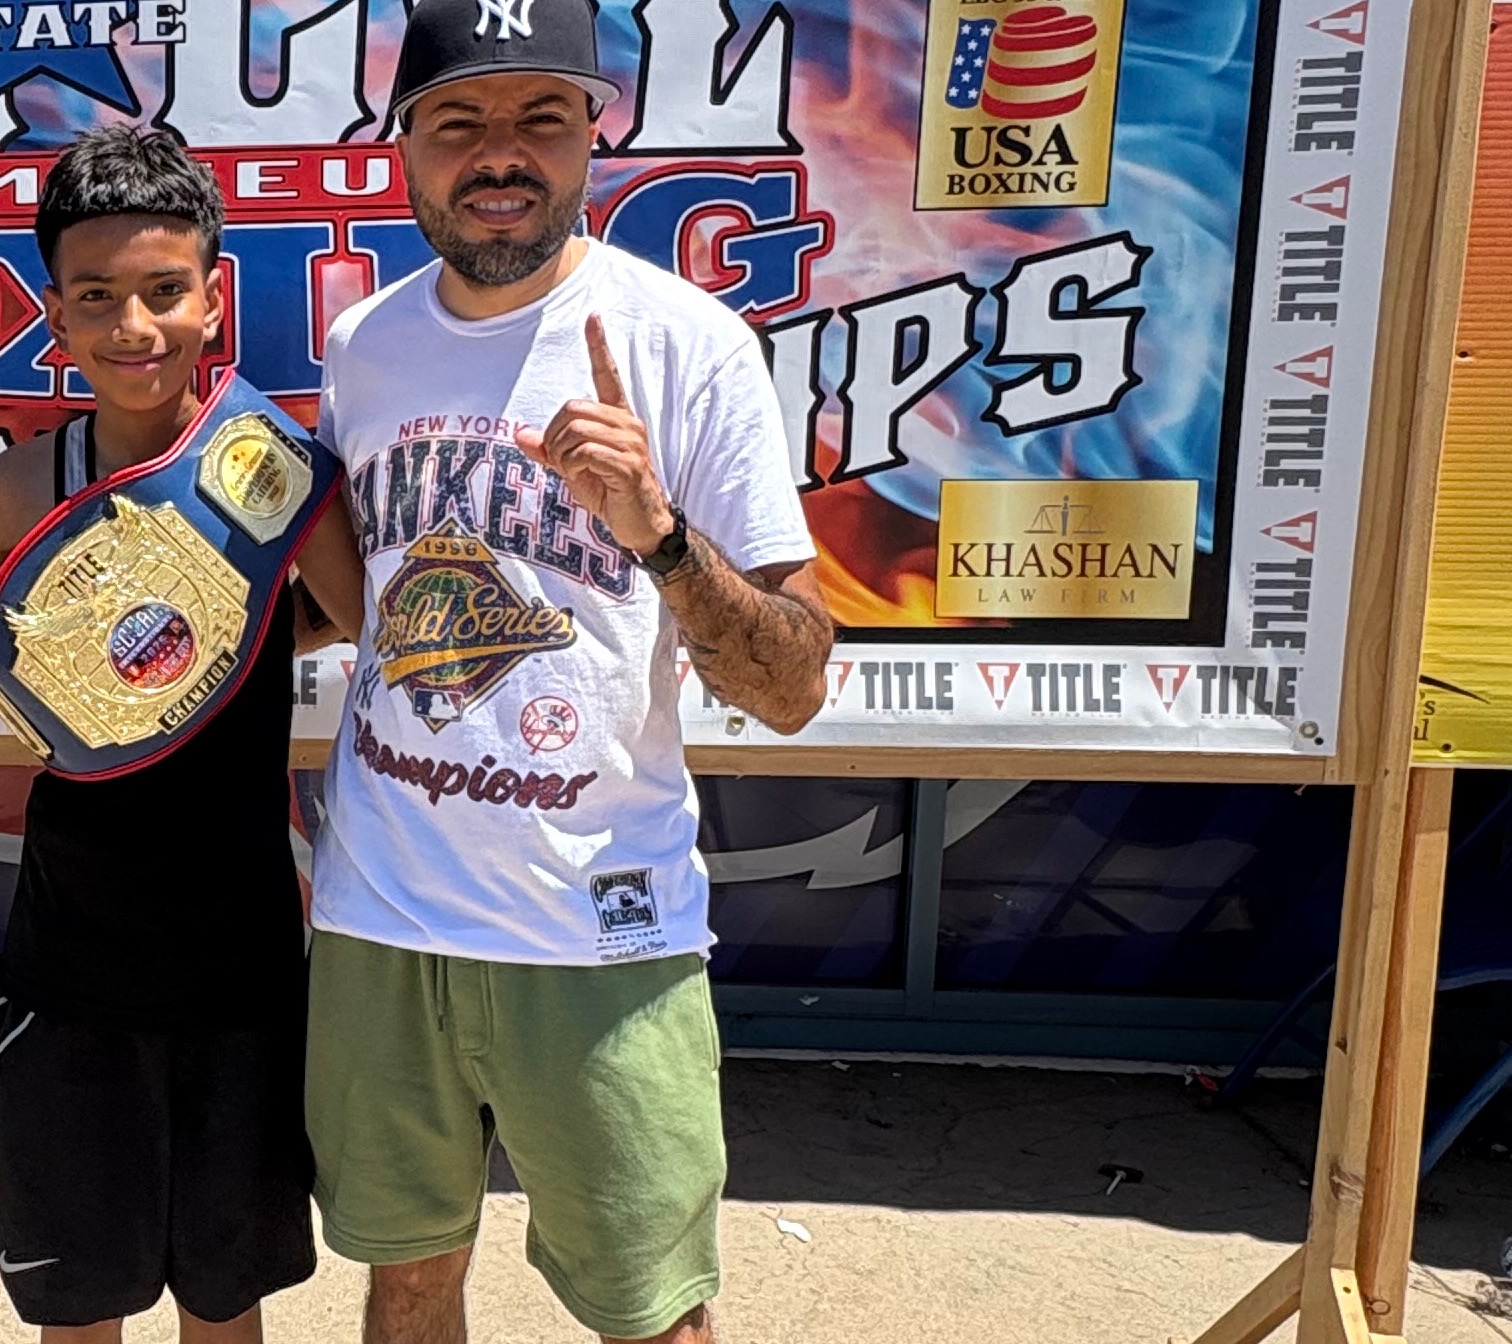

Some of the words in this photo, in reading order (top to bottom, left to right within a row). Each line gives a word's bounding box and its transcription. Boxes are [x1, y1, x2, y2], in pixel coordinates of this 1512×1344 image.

[1294, 51, 1364, 152] TITLE
[950, 123, 1079, 169] USA
[945, 170, 1078, 195] BOXING
[1277, 225, 1345, 322] TITLE
[398, 415, 448, 441] NEW
[1262, 394, 1329, 487] TITLE
[948, 542, 1183, 579] KHASHAN
[452, 583, 575, 644] Series
[978, 588, 1036, 603] LAW
[1061, 588, 1136, 604] FIRM
[1250, 558, 1313, 649] TITLE
[163, 656, 232, 726] CHAMPION
[860, 662, 954, 710] TITLE
[1026, 663, 1122, 712] TITLE
[1196, 665, 1298, 716] TITLE
